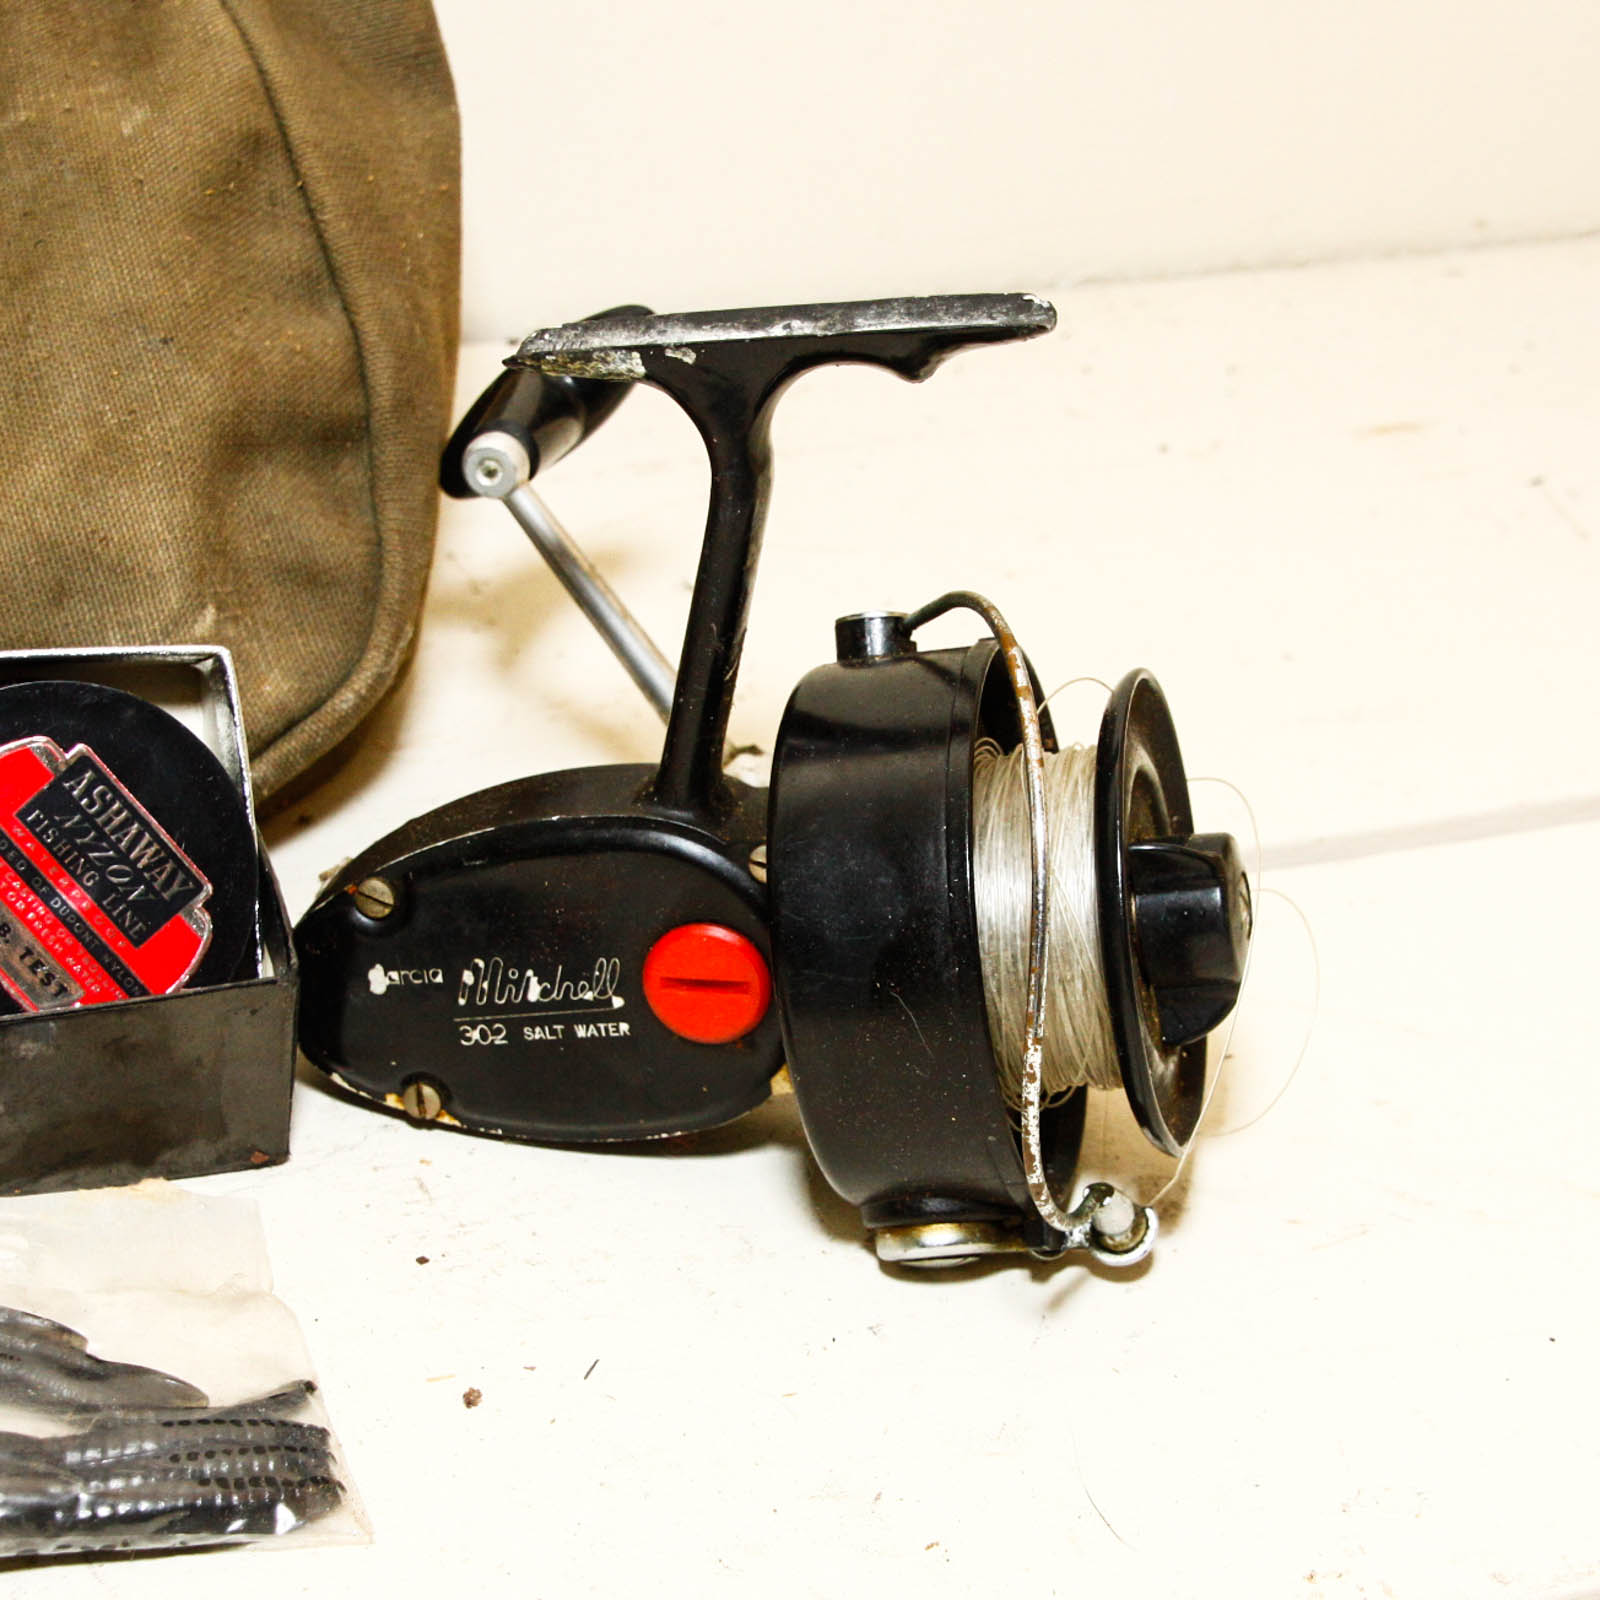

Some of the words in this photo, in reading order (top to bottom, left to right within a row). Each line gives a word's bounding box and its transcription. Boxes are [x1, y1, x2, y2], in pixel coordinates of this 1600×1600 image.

[54, 813, 158, 902] NYLON
[62, 768, 198, 902] ASHAWAY
[26, 809, 99, 888] FISHING
[102, 892, 148, 940] LINE
[20, 945, 69, 998] TEST
[49, 896, 100, 950] DUPONT
[103, 953, 139, 996] NYLON
[66, 956, 101, 993] WATER
[368, 964, 443, 995] arcia
[459, 1024, 508, 1045] 302
[523, 1025, 564, 1040] SALT
[574, 1021, 630, 1039] WATER
